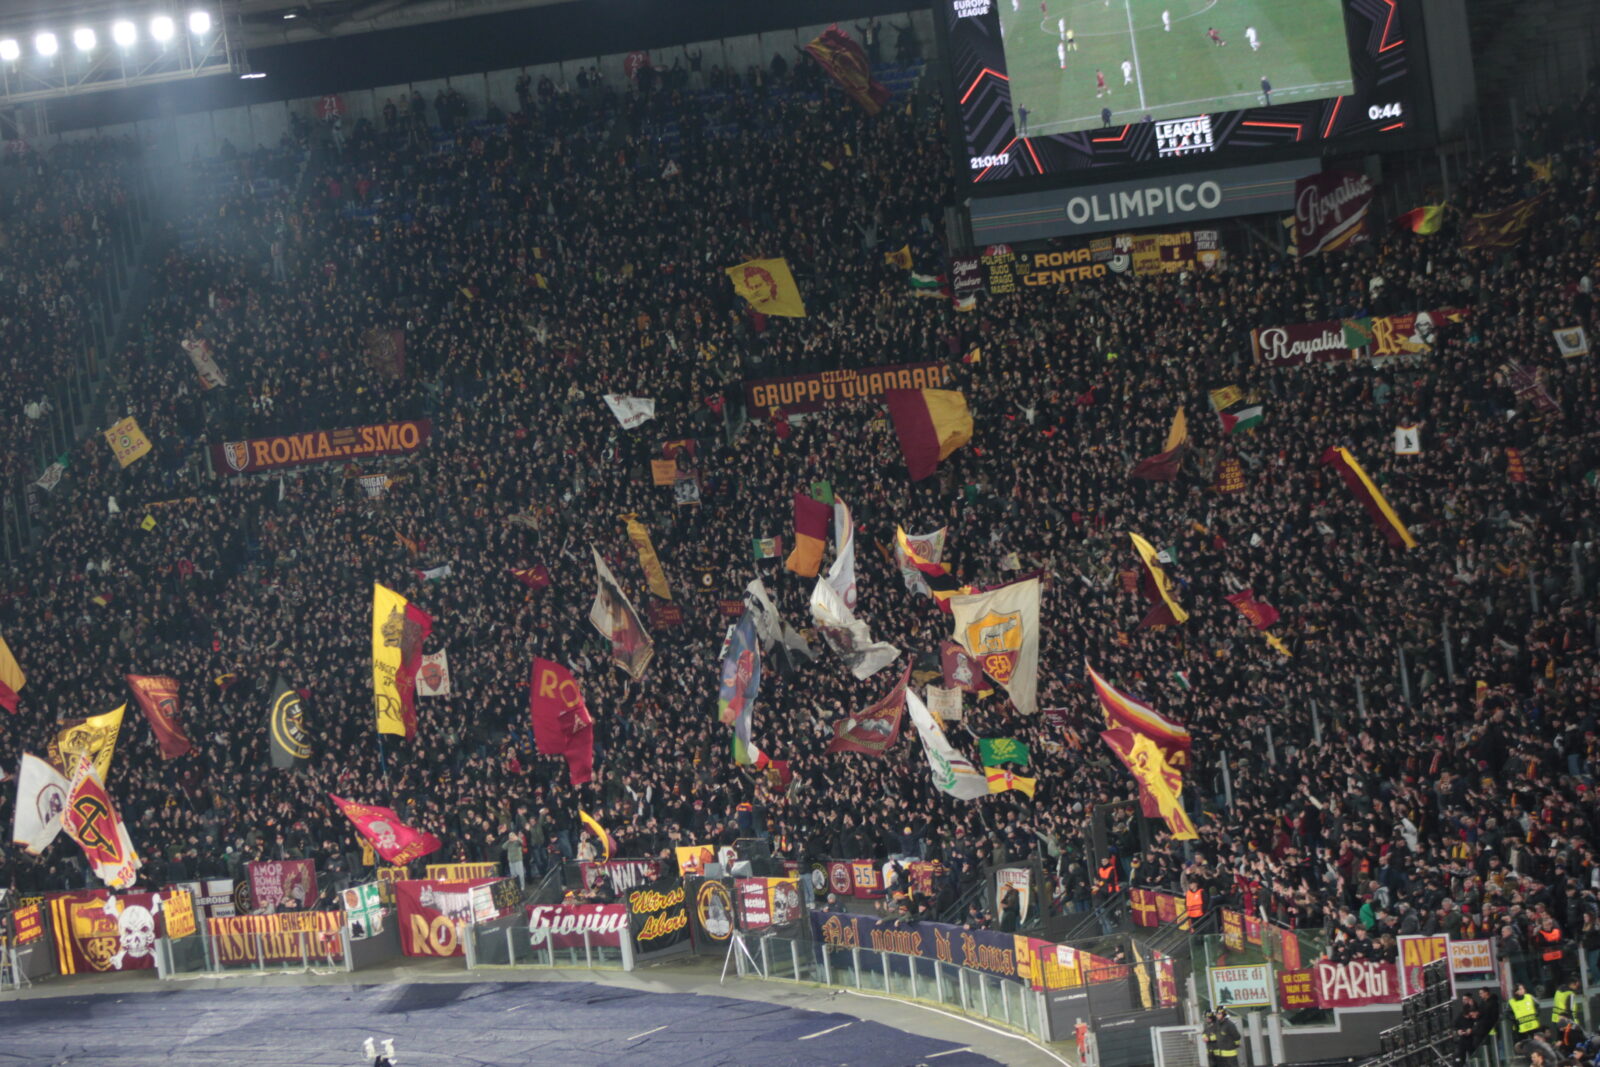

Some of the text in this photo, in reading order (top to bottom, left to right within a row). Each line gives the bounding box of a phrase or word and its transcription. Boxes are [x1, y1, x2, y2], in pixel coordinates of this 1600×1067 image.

[957, 6, 989, 18] LEAGUE
[1368, 102, 1402, 120] 0:44
[1155, 119, 1212, 140] LEAGUE
[1157, 132, 1213, 150] PHASE
[970, 152, 1010, 169] 21:01:17
[1066, 181, 1222, 224] OLIMPICO
[1034, 248, 1092, 268] ROMA
[1023, 263, 1107, 286] CENTRO
[253, 862, 284, 876] AMOR
[253, 874, 282, 887] ROMAE
[629, 886, 686, 915] Ultras
[636, 908, 688, 941] Liberi
[871, 928, 924, 957] nome
[934, 927, 954, 964] di
[960, 931, 1016, 976] Roma
[1214, 967, 1263, 983] FIGLIE di
[1233, 987, 1268, 1002] ROMA
